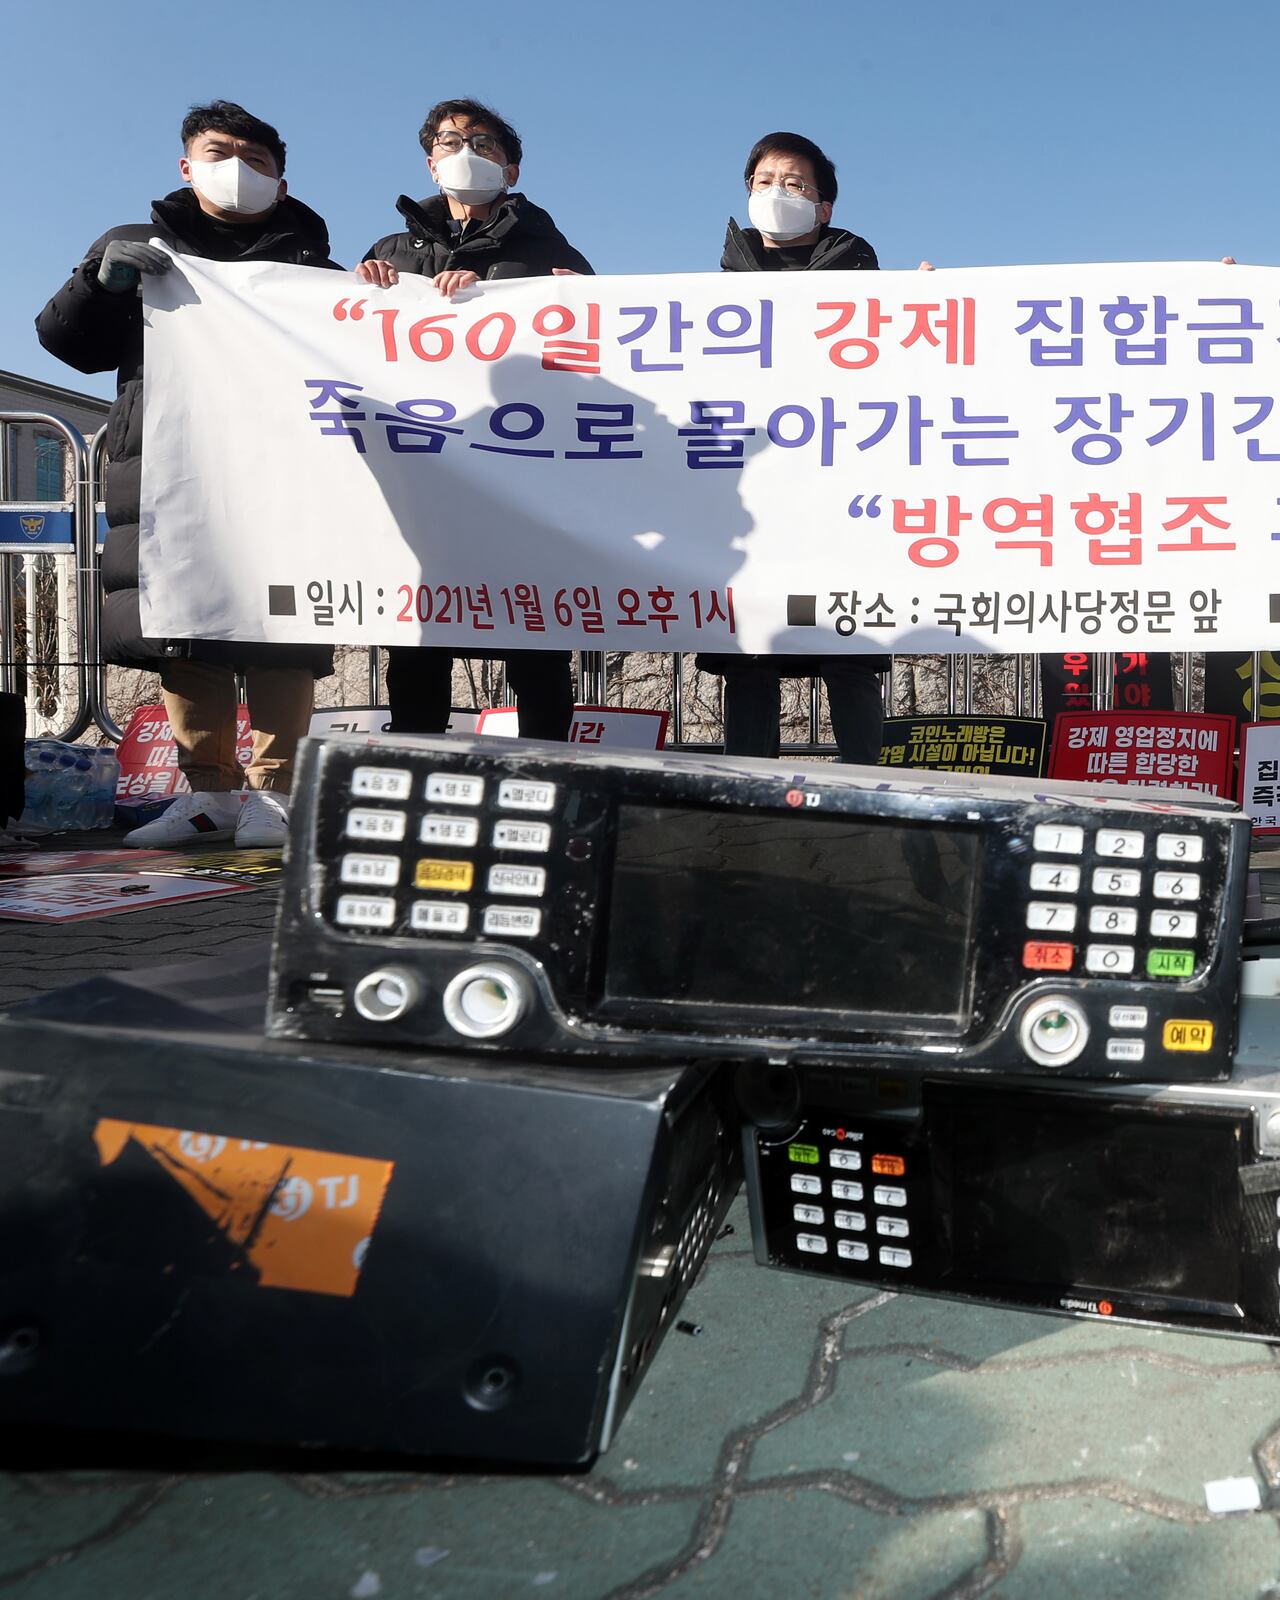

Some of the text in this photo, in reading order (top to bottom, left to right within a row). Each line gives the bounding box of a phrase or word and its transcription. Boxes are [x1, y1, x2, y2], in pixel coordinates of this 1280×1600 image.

[815, 297, 976, 370] 강제
[304, 379, 643, 460] 죽음으로
[677, 396, 1018, 470] 몰아가는
[849, 493, 1236, 568] “방역협조
[305, 579, 364, 626] 일시
[396, 583, 493, 630] 2021년
[501, 583, 545, 632] 1월
[554, 586, 606, 634] 6일
[618, 586, 680, 632] 오후
[690, 586, 736, 634] 1시
[827, 590, 897, 637] 장소
[934, 589, 1176, 637] 국회의사당정문
[1189, 588, 1222, 634] 앞
[908, 725, 1006, 744] 코인노래방은
[1068, 726, 1219, 752] 강제 영업정지에
[908, 744, 957, 763] 시설이
[962, 744, 1036, 766] 아닙니다!
[1086, 752, 1199, 777] 따른 합당한
[1054, 832, 1063, 849] 1
[1112, 838, 1126, 855] 2
[1173, 841, 1187, 858] 3
[1049, 871, 1062, 888] 4
[1108, 874, 1122, 891] 5
[1171, 878, 1183, 895] 6
[1045, 908, 1057, 925] 7
[1105, 912, 1119, 929] 8
[1168, 915, 1181, 932] 9
[1034, 948, 1064, 964] 취소
[1102, 950, 1120, 968] 0
[1157, 957, 1187, 971] 시작
[1170, 1028, 1207, 1045] 예약
[317, 1175, 360, 1209] TJ
